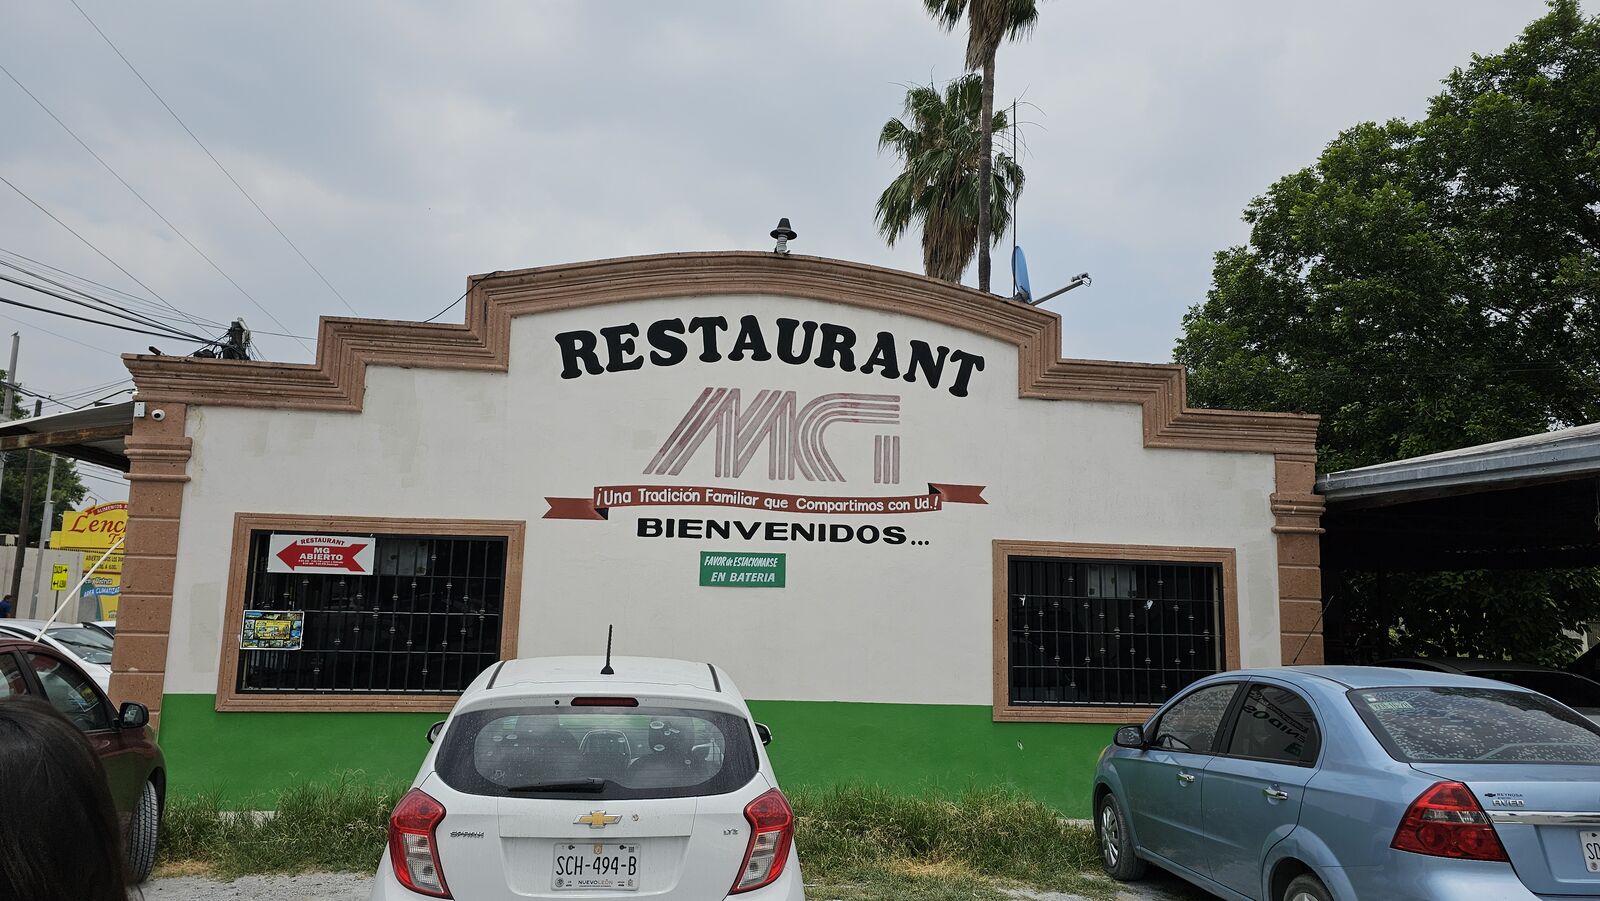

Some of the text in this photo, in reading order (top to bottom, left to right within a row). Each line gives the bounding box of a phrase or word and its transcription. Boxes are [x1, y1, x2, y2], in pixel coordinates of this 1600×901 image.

[555, 315, 985, 397] RESTAURANT
[643, 387, 900, 484] MG
[596, 488, 632, 506] ¡Una
[638, 488, 700, 503] Tradición
[705, 489, 759, 507] Familiar
[764, 497, 789, 510] que
[796, 497, 884, 513] Compartimos
[888, 501, 910, 511] con
[68, 515, 127, 534] Lenc
[300, 537, 345, 546] RESTAURANT
[299, 553, 344, 561] ABIERTO
[704, 556, 727, 566] FAVOR
[733, 556, 778, 567] ESTACIONARSE
[710, 572, 776, 582] EN BATERIA
[555, 855, 637, 876] SCH-494-B
